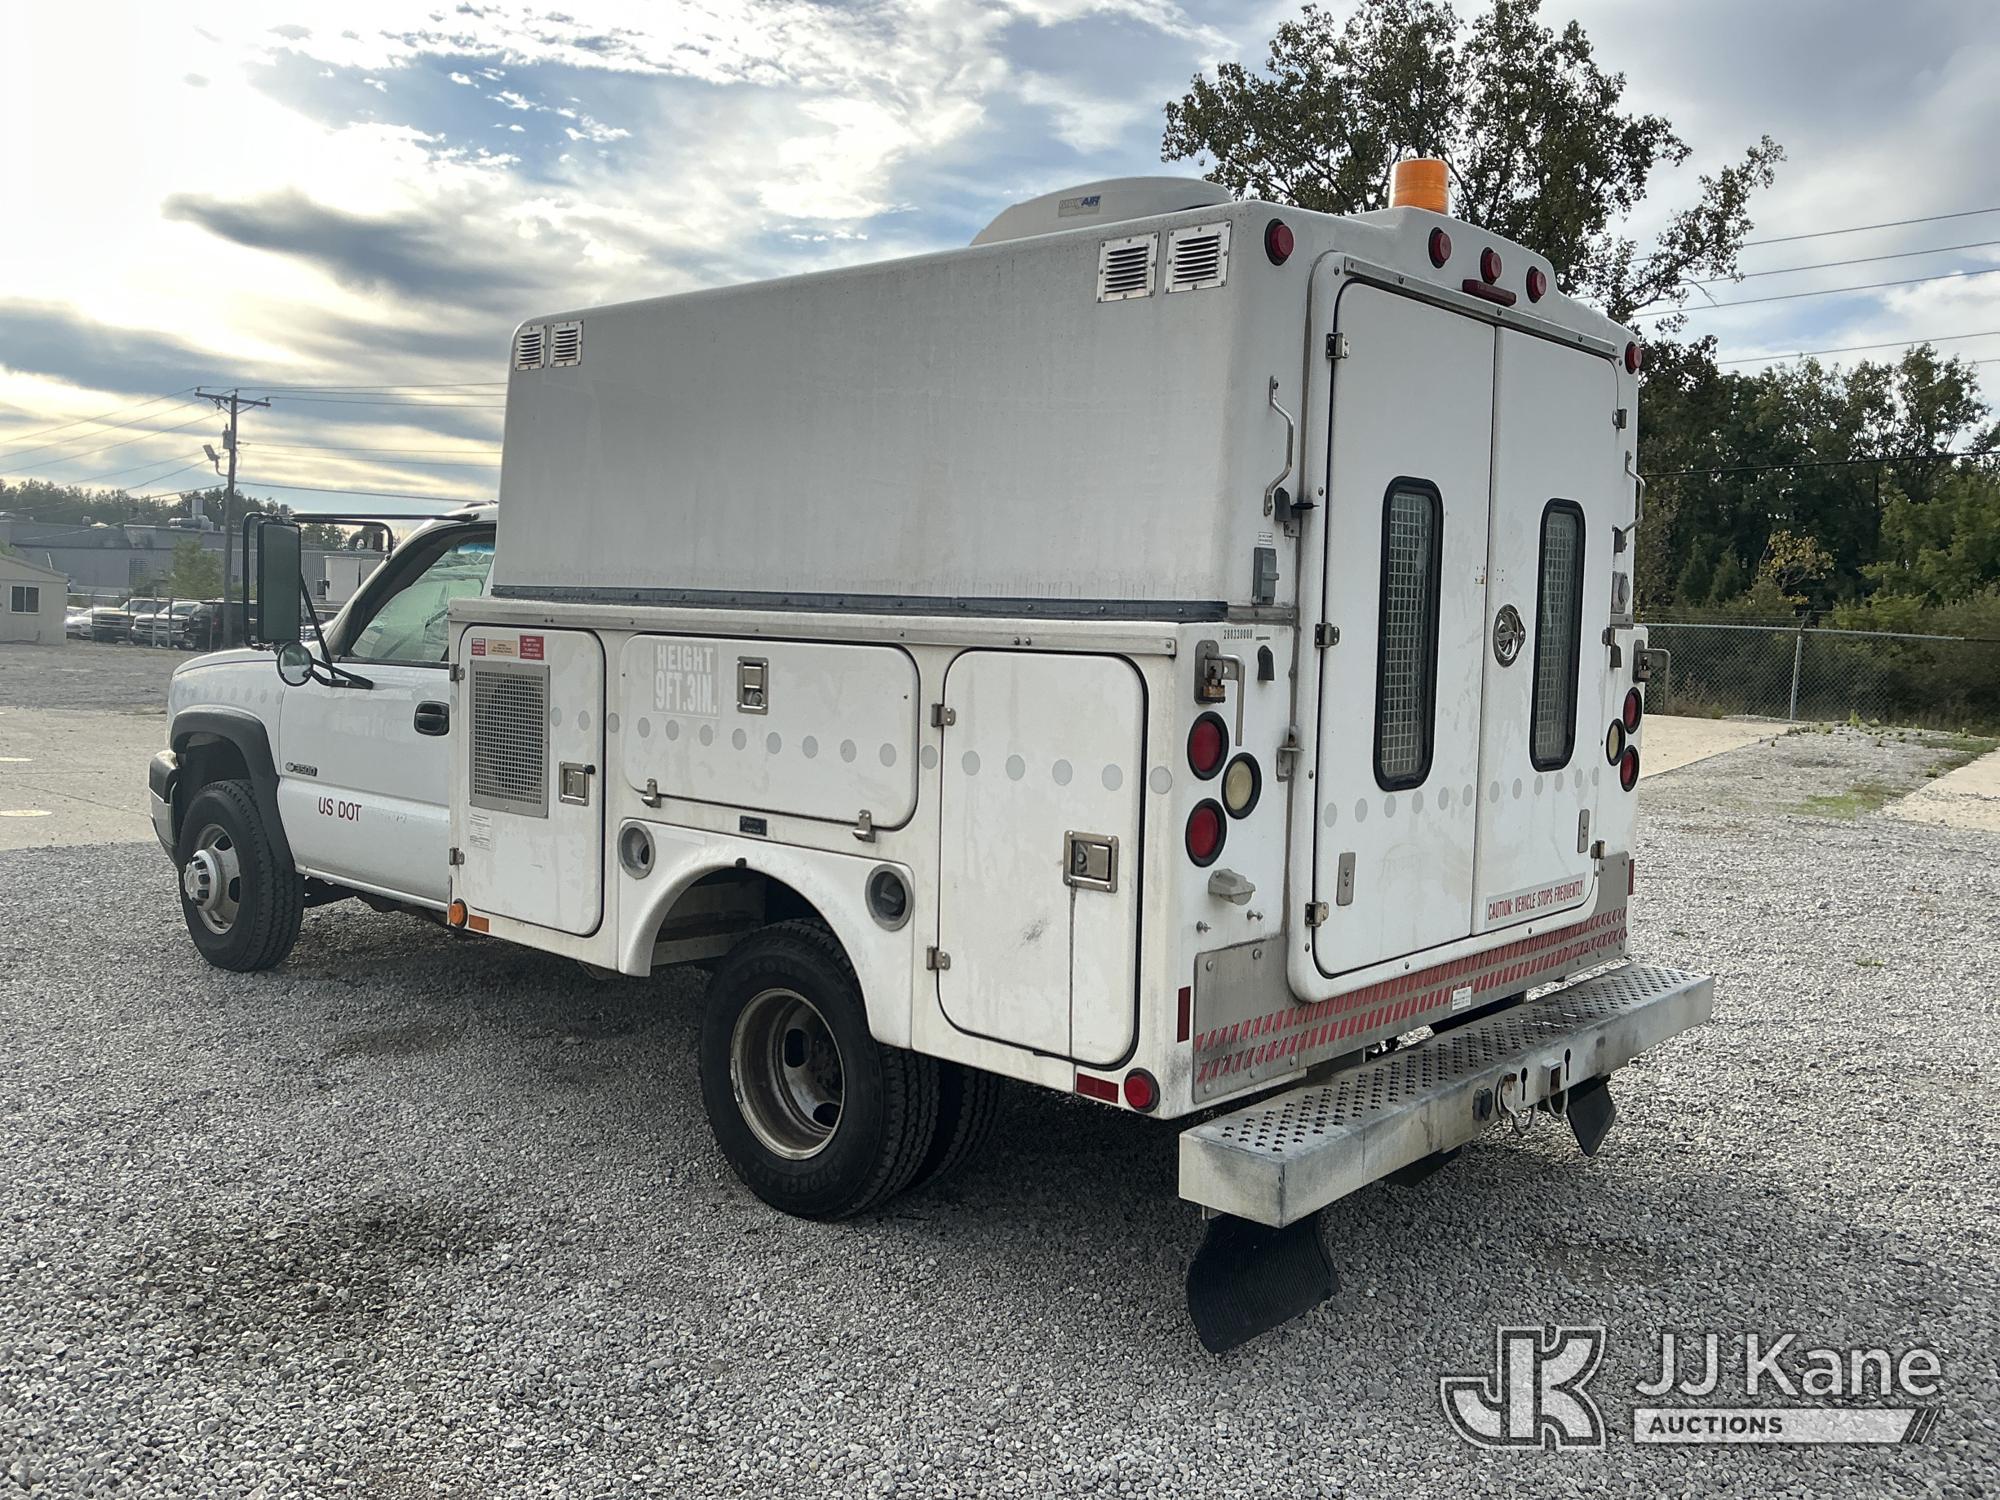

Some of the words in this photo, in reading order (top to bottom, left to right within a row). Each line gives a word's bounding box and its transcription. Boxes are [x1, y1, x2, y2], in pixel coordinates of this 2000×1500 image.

[656, 644, 714, 673] HEIGHT
[318, 796, 334, 816] US
[338, 800, 362, 821] DOT
[1515, 892, 1536, 913] VEHICLE
[1537, 887, 1553, 907] STOPS
[1554, 879, 1584, 902] FREQUENTLY
